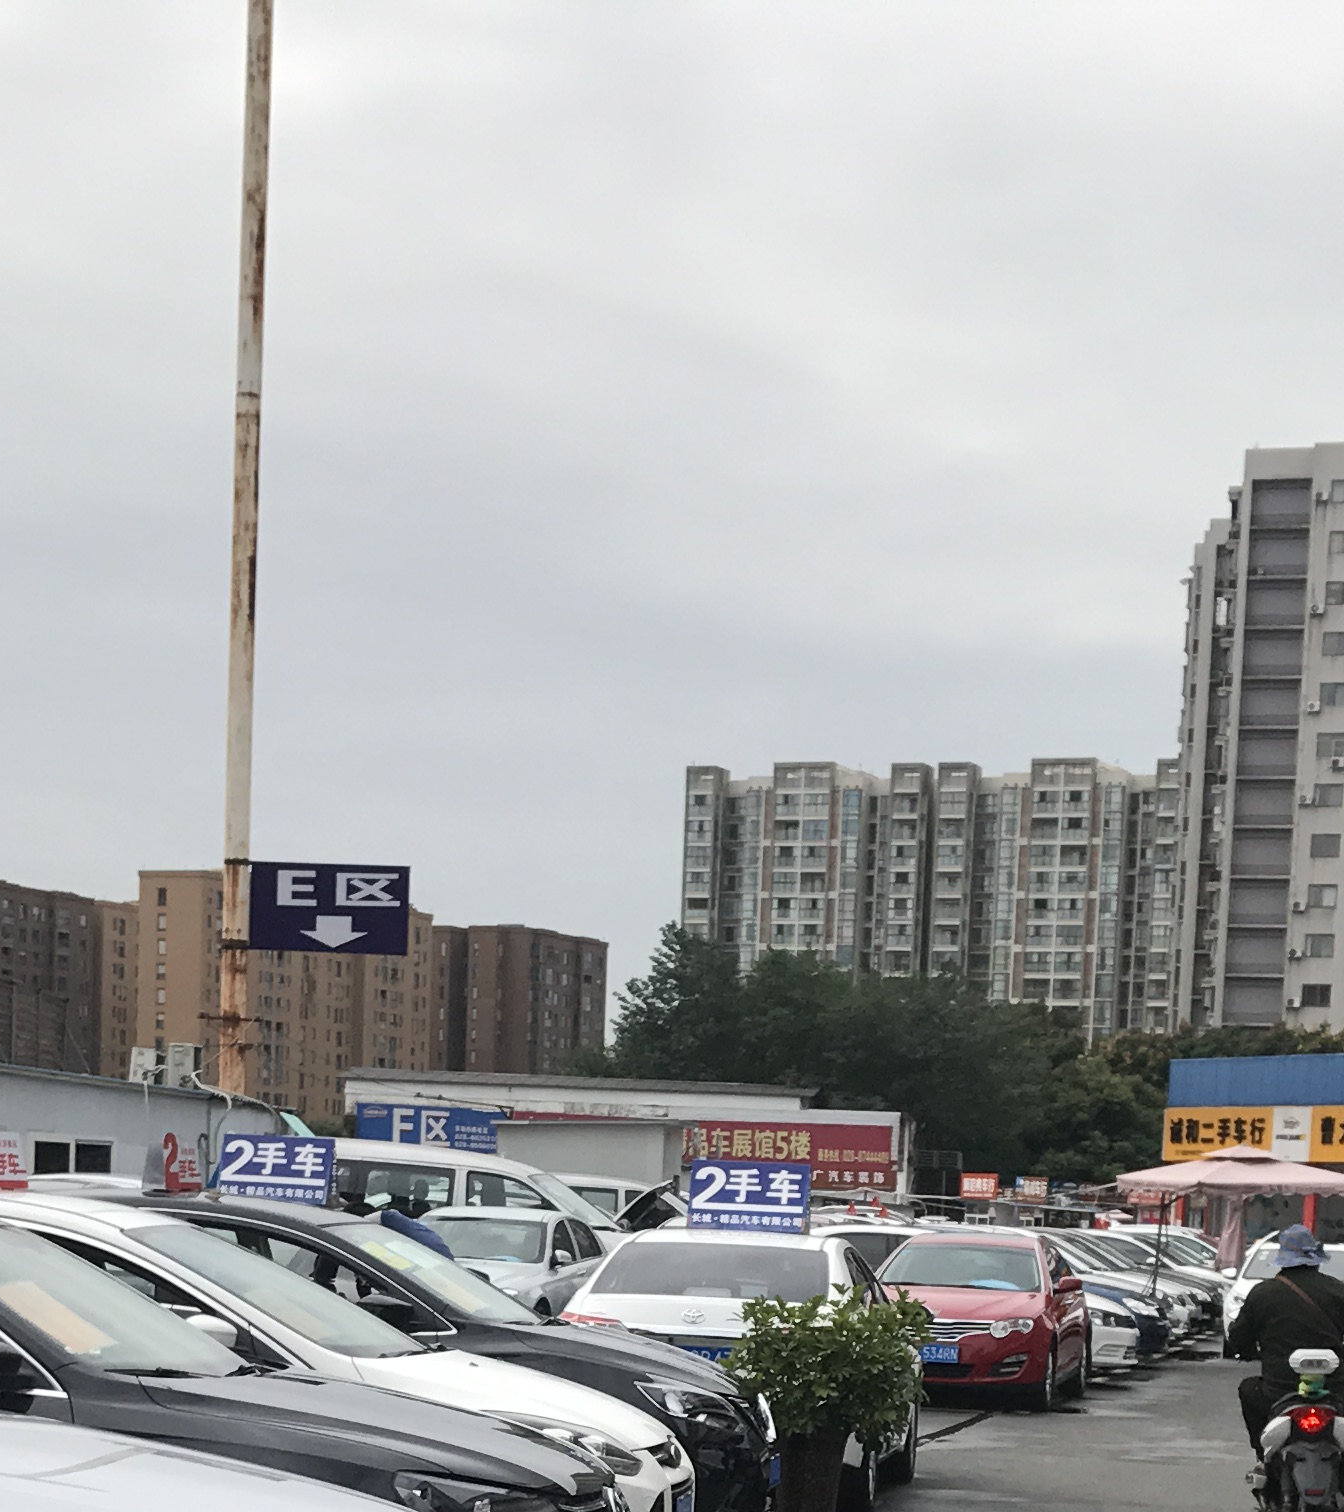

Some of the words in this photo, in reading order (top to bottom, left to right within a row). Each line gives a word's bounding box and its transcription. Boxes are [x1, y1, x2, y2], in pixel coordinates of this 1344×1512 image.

[277, 870, 401, 907] E区
[392, 1108, 451, 1147] F区
[220, 1139, 327, 1183] 2手车
[691, 1166, 803, 1210] 2手车
